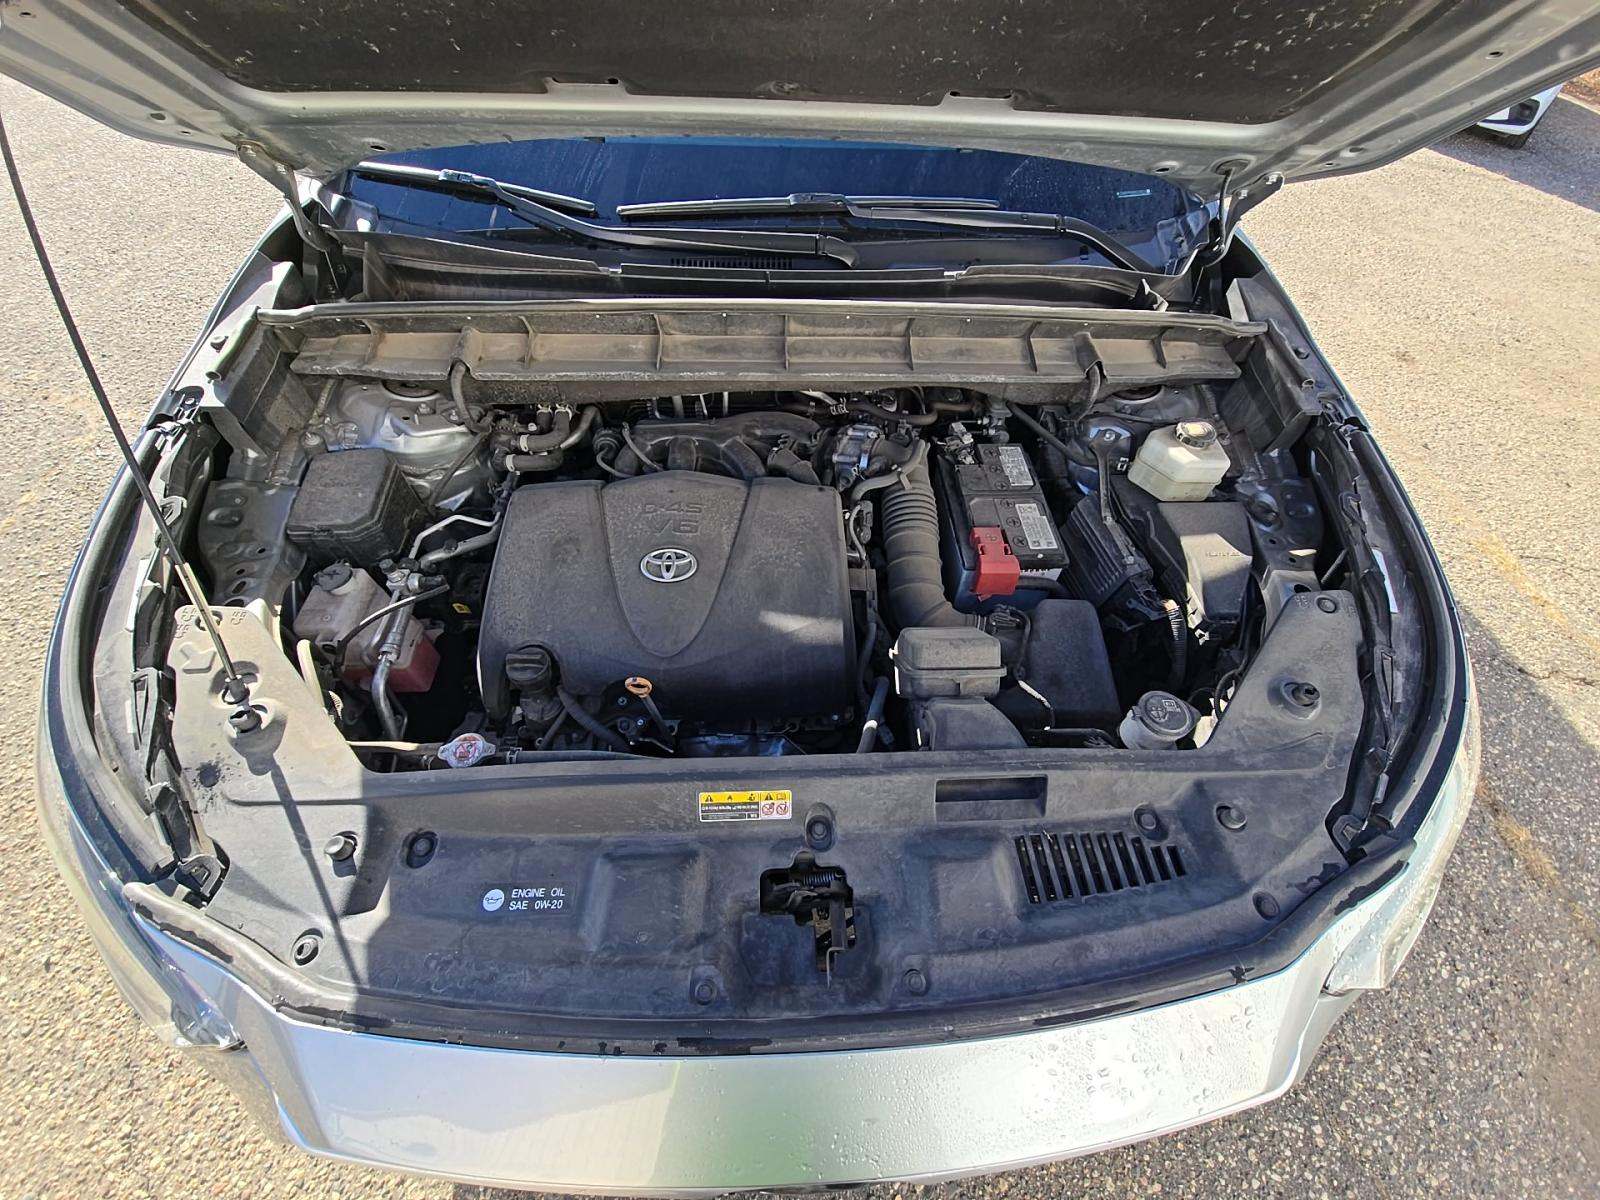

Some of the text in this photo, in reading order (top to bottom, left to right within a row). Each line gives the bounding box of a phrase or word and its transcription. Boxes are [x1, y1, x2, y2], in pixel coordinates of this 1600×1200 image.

[648, 518, 701, 536] V6
[511, 887, 566, 898] ENGINE OIL
[508, 899, 563, 910] SAE 0W-20
